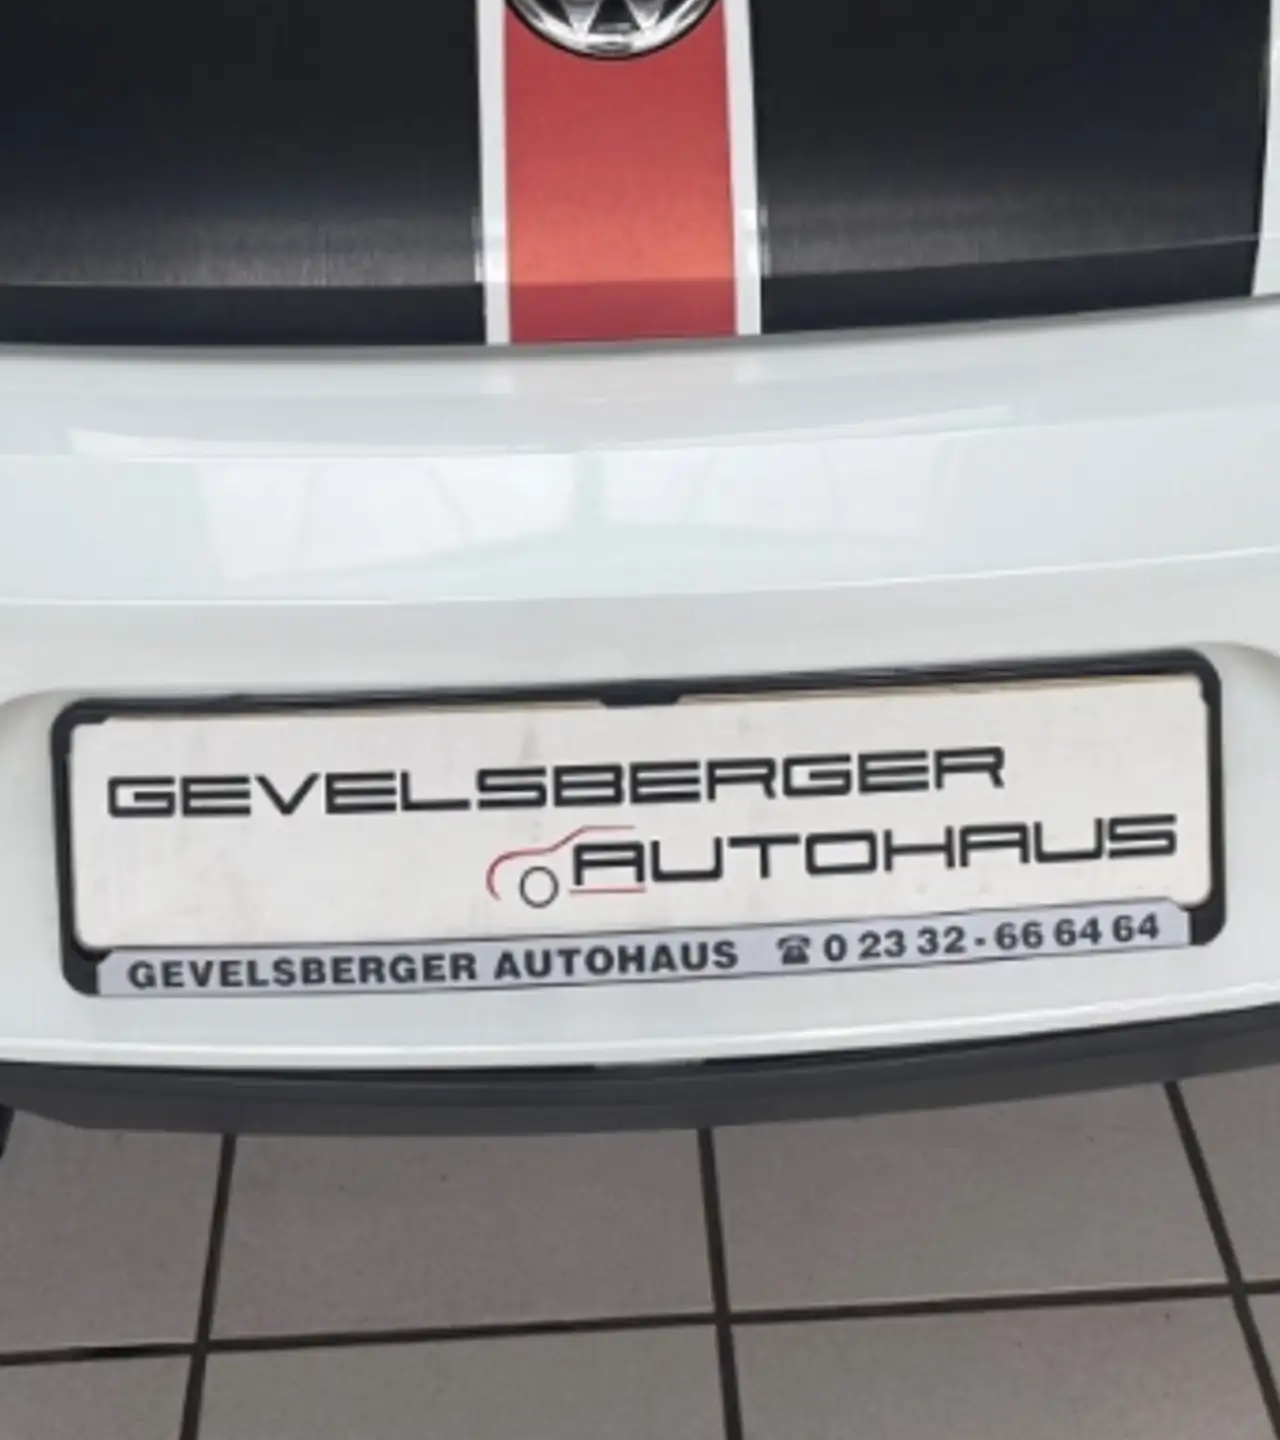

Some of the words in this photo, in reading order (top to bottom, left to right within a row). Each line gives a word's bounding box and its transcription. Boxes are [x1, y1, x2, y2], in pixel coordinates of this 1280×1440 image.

[107, 746, 1005, 818] GEVELSBERGER
[572, 814, 1177, 886] AUTOHAUS
[127, 952, 478, 990] GEVELSBERGER
[493, 940, 739, 980] AUTOHAUS
